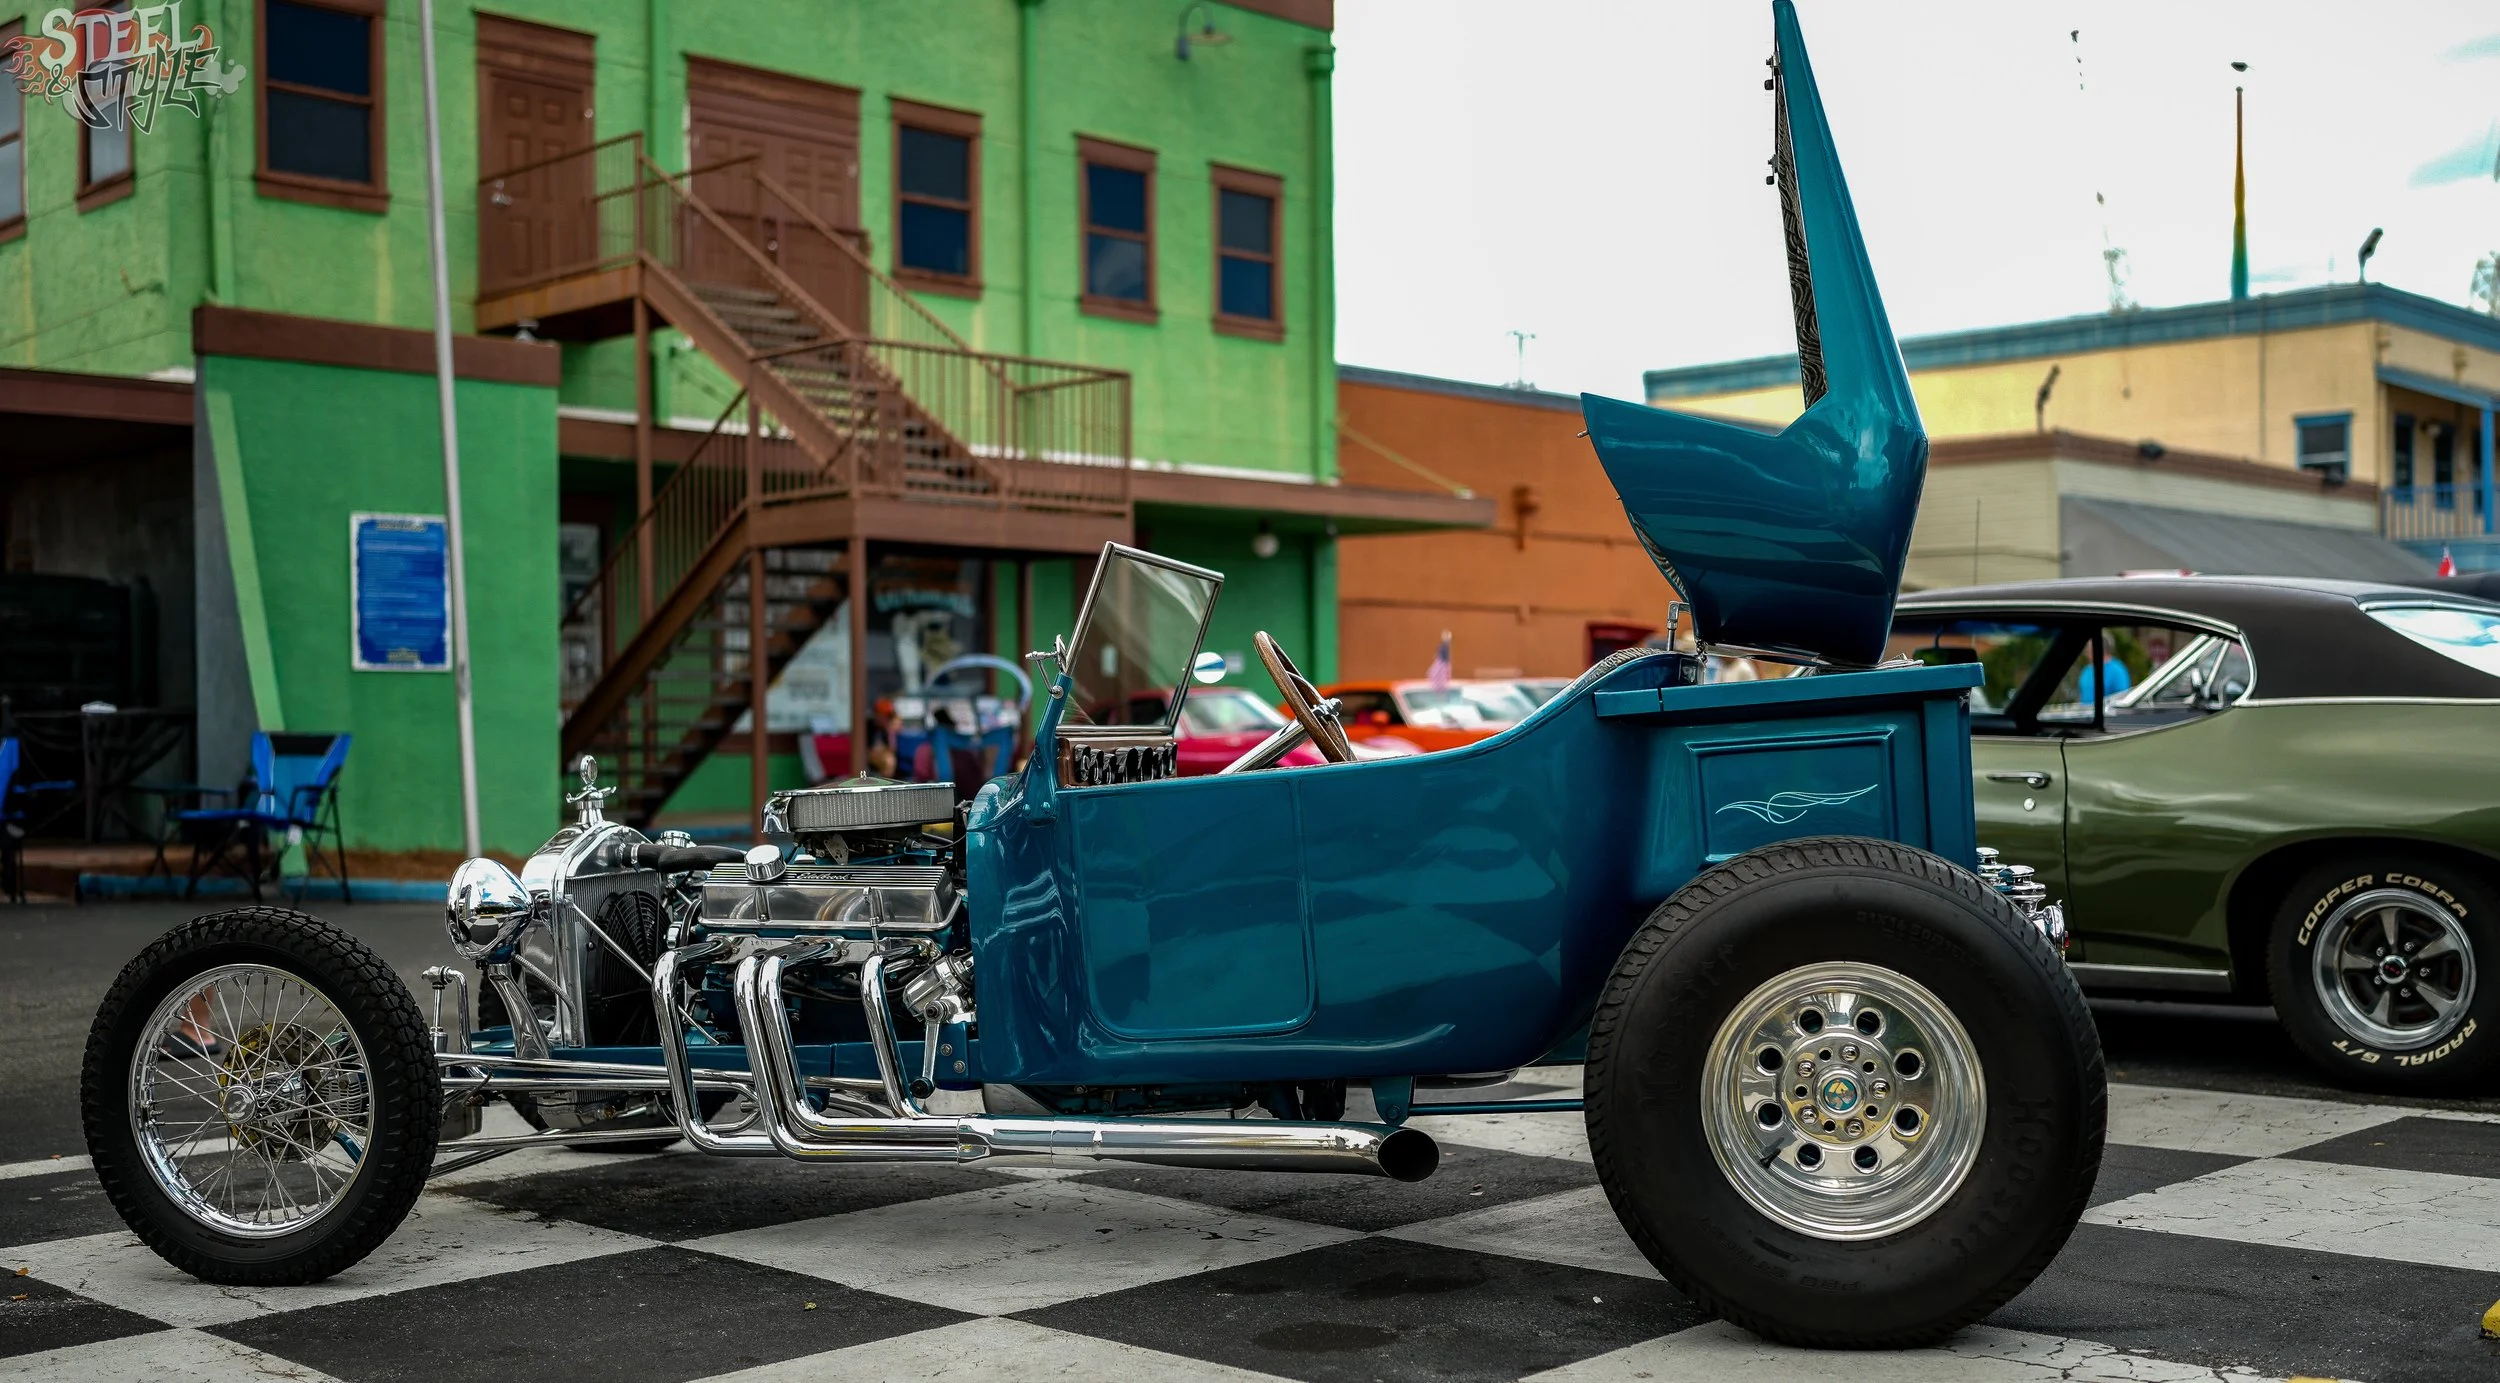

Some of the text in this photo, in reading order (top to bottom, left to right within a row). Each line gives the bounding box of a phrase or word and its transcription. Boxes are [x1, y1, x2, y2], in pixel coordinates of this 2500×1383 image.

[2297, 872, 2468, 947] COOPER COBRA
[2332, 1017, 2478, 1067] RADIAL G/T
